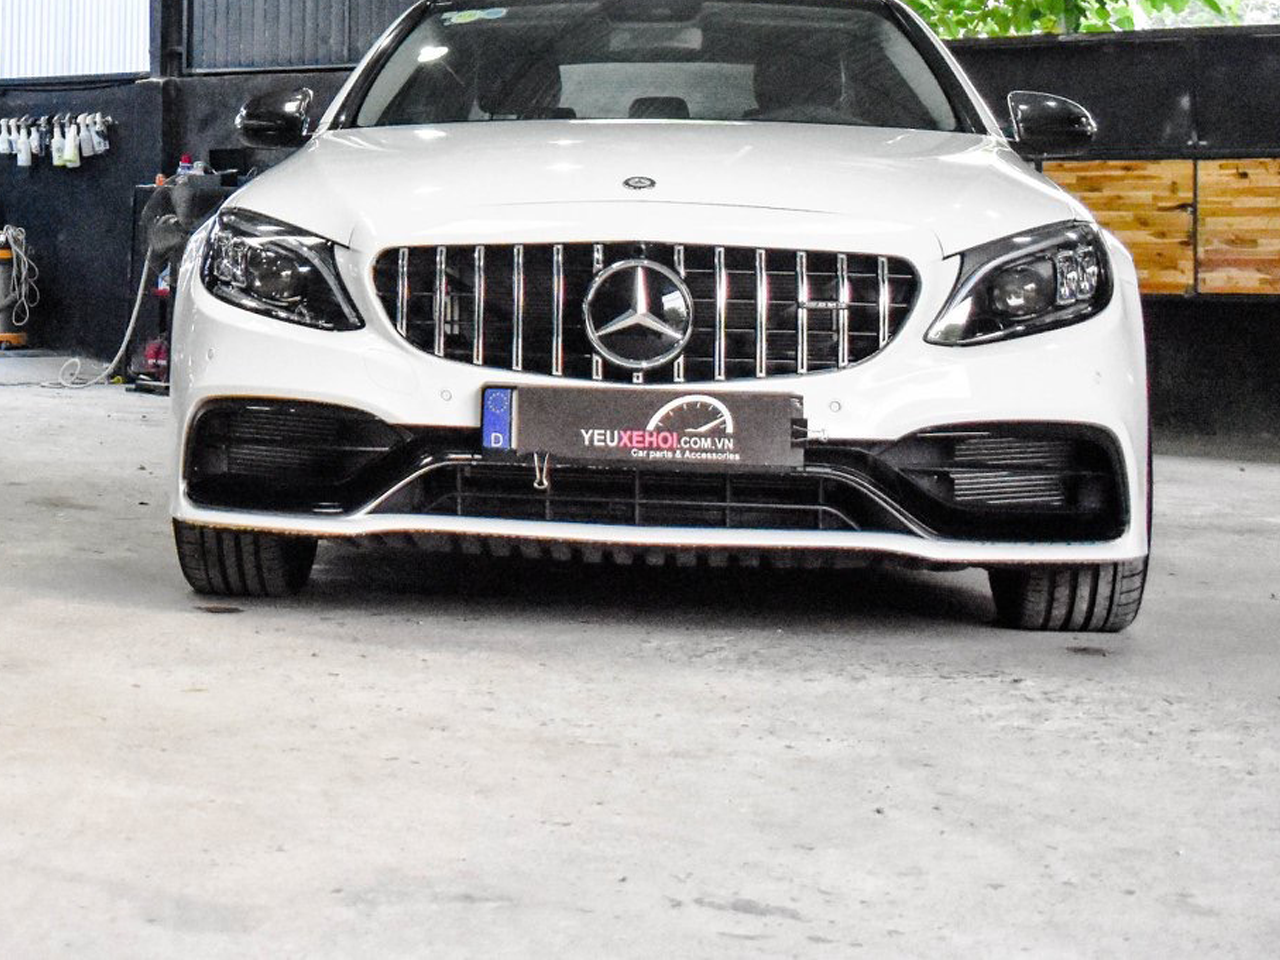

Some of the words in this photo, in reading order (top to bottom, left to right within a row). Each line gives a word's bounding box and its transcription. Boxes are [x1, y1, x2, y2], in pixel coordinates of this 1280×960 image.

[490, 433, 504, 448] D
[580, 428, 734, 450] YEUXEHOI.COM.VN
[631, 448, 647, 457] Car
[649, 449, 673, 459] parts
[675, 450, 682, 458] &
[684, 450, 740, 460] Accessories
